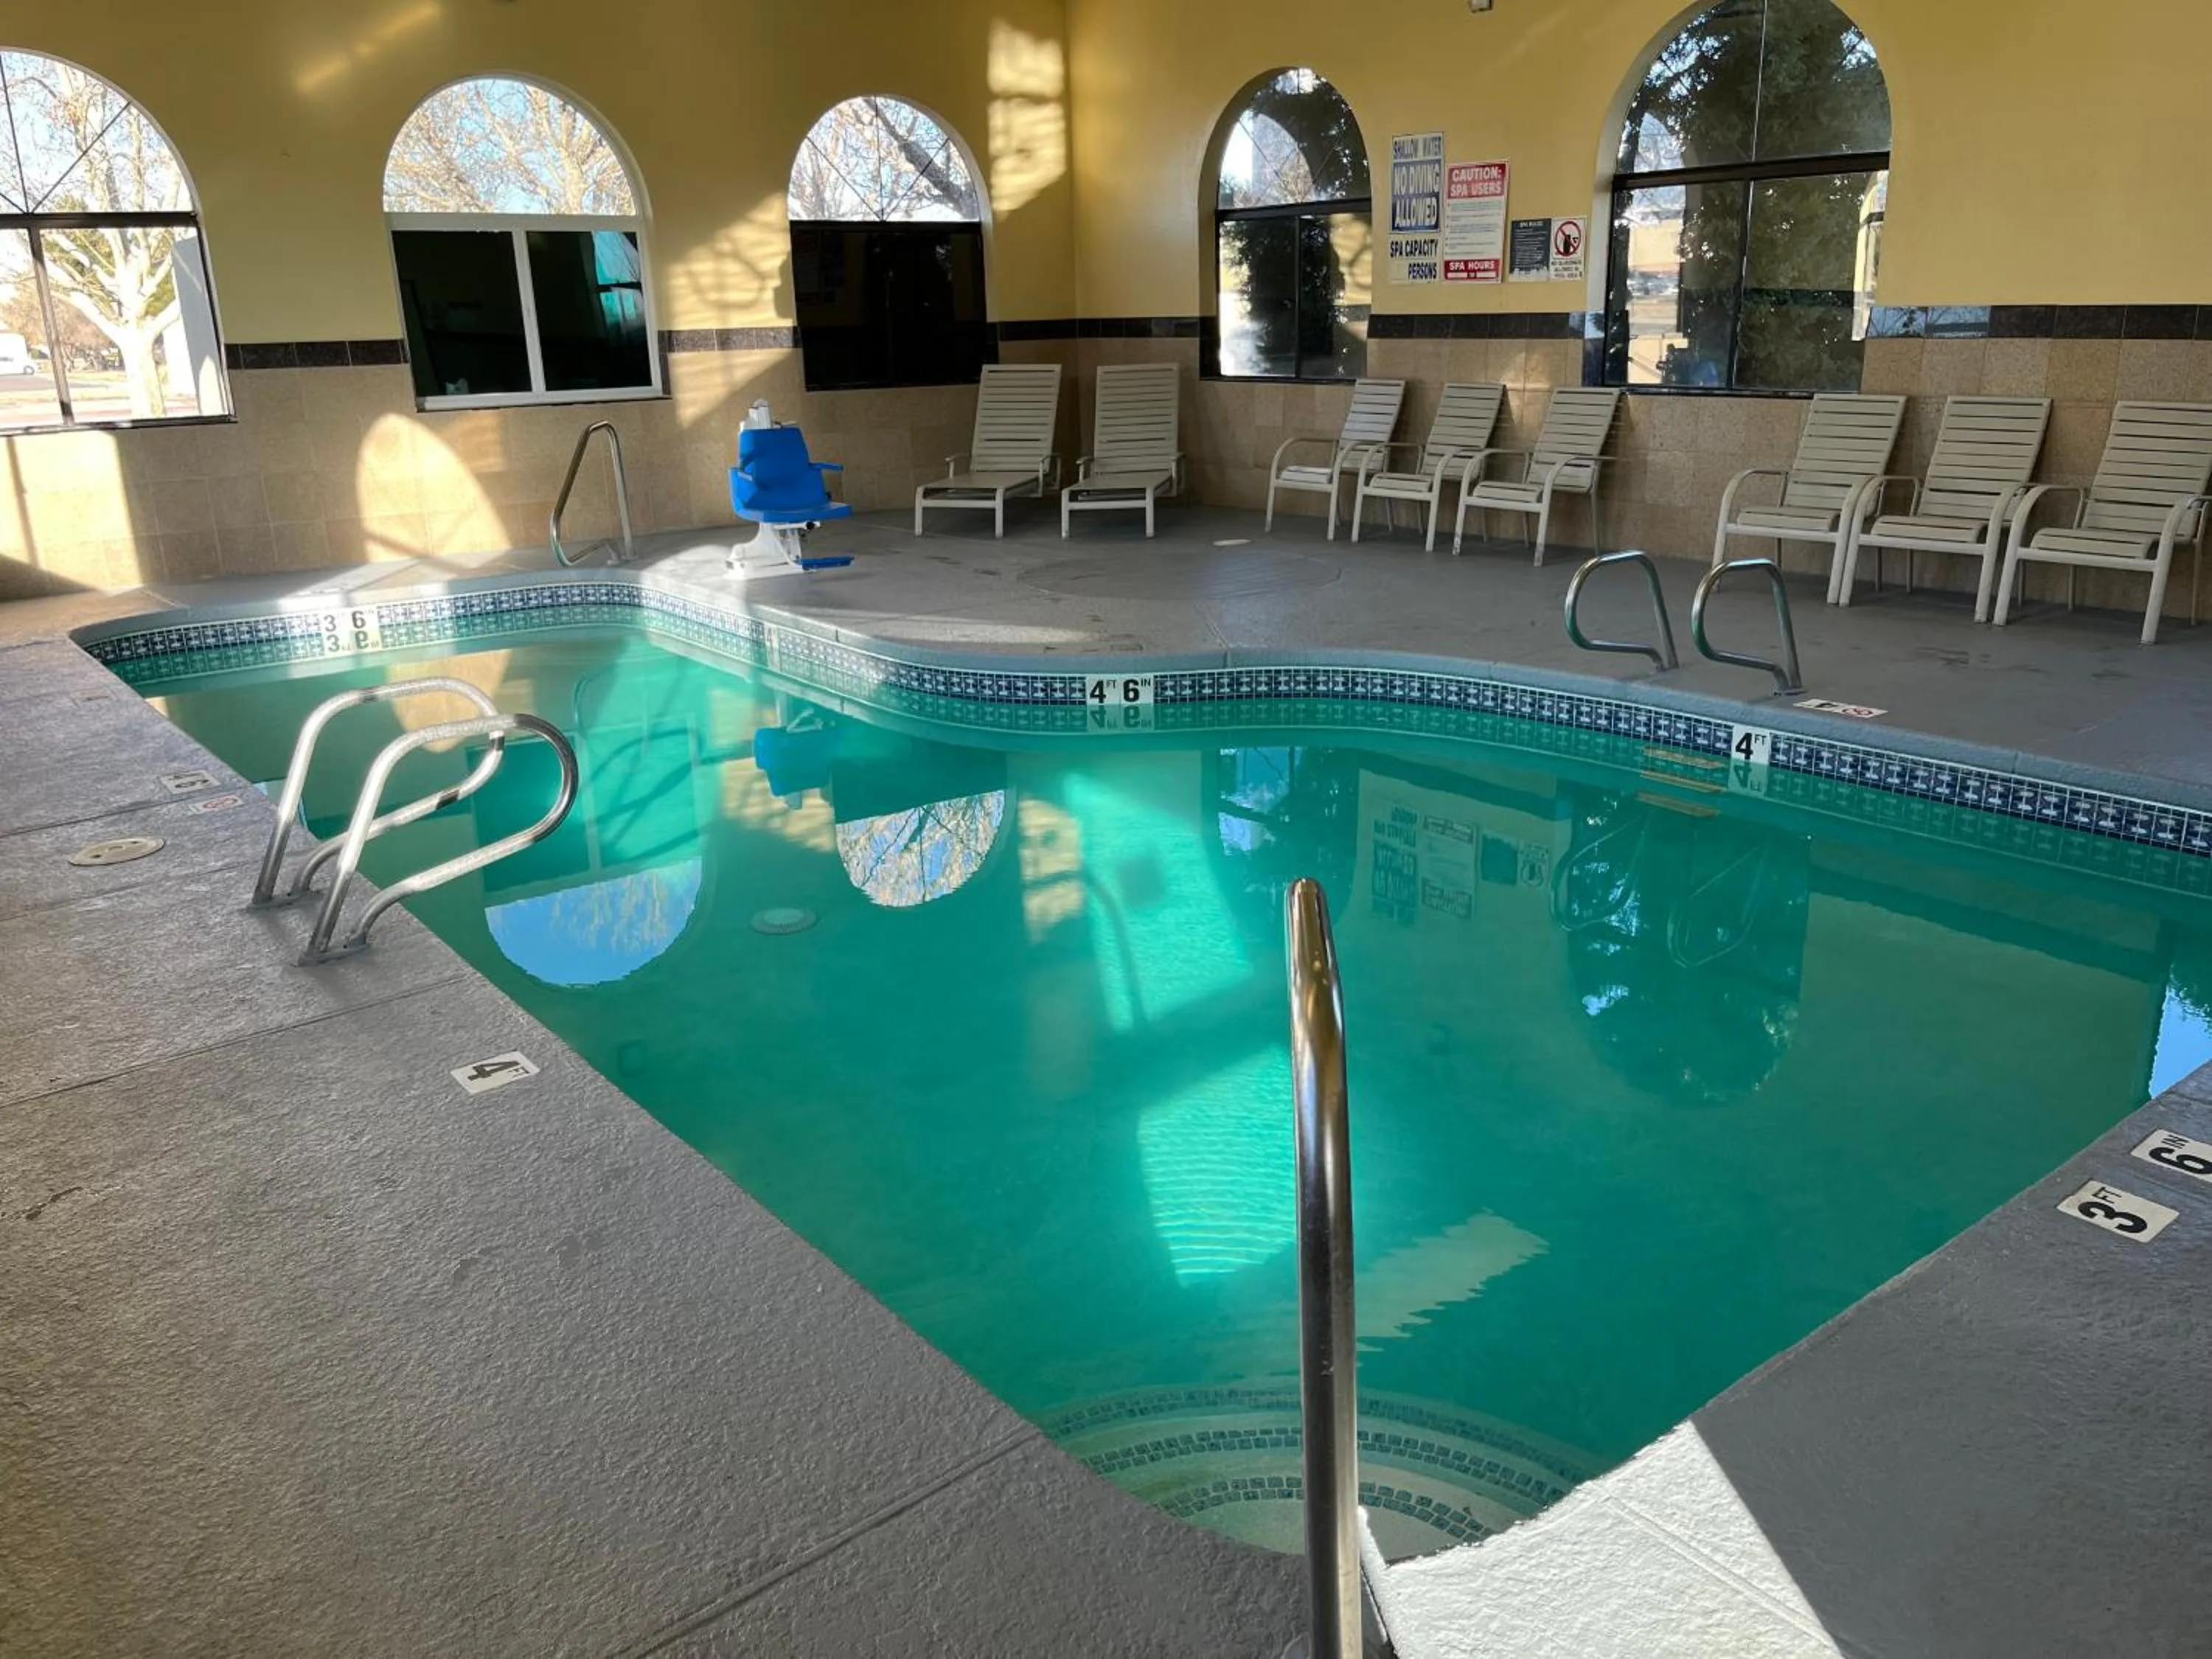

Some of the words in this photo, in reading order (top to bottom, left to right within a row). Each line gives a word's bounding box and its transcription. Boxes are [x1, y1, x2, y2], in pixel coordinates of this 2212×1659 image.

[1394, 164, 1407, 195] NO
[1409, 162, 1439, 193] DIVING
[1452, 167, 1502, 183] CAUTION:
[1450, 184, 1468, 197] SPA
[1471, 181, 1502, 195] USERS
[1394, 196, 1437, 227] ALLOWED
[1390, 240, 1403, 258] SPA
[1405, 238, 1439, 257] CAPACITY
[1408, 262, 1437, 279] PERSONS
[1449, 262, 1466, 271] SPA
[1468, 260, 1495, 270] HOURS
[324, 614, 337, 632] 3
[352, 610, 366, 629] 6
[1090, 680, 1106, 703] 4
[1123, 679, 1139, 702] 6
[1141, 678, 1151, 687] IN
[1735, 732, 1753, 759] 4
[1755, 734, 1767, 746] FT
[467, 1061, 521, 1081] 4
[2161, 1134, 2189, 1150] IN
[2149, 1147, 2212, 1174] 6
[2092, 1186, 2122, 1204] FT
[2078, 1201, 2148, 1234] 3
